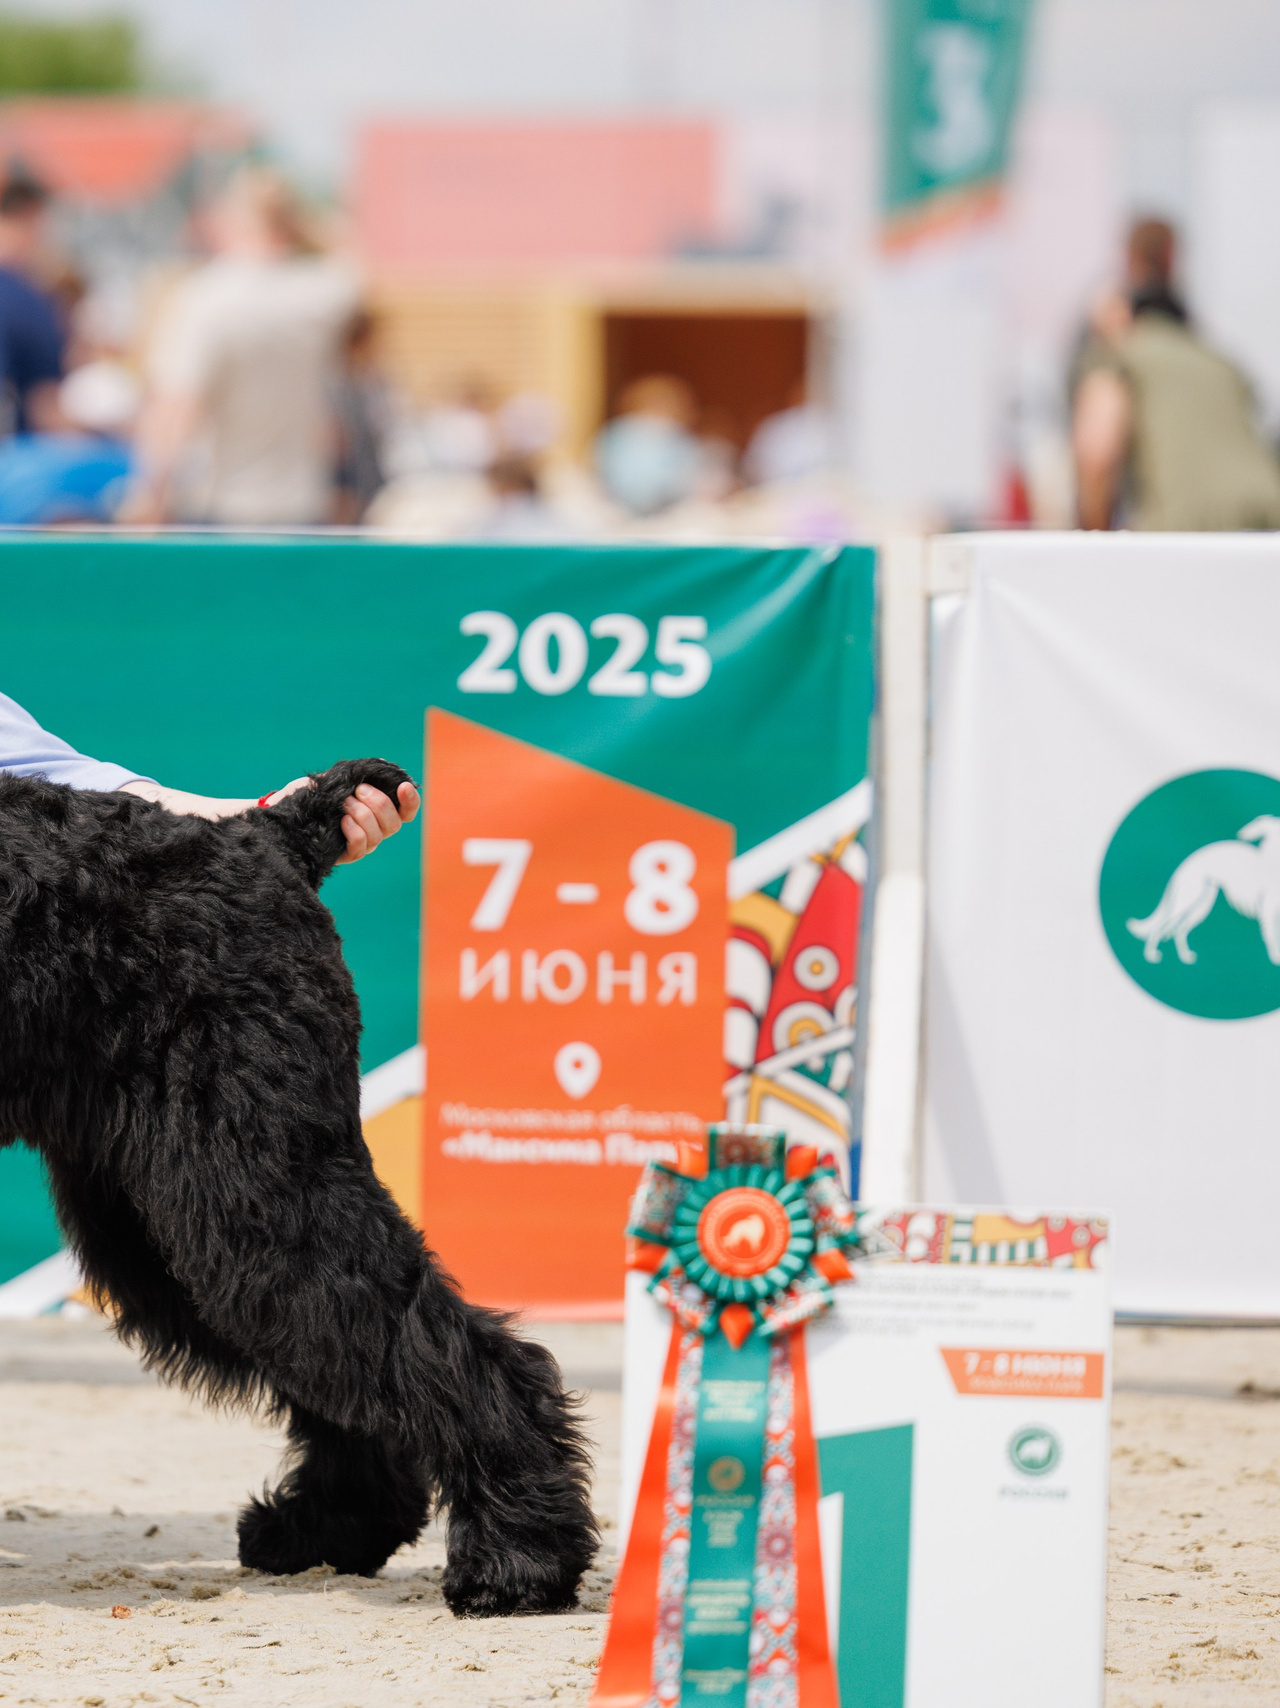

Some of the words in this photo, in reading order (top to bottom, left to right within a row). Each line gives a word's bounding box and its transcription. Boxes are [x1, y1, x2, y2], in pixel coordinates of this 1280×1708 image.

[457, 611, 713, 698] 2025
[462, 837, 533, 932] 7
[623, 840, 699, 935] 8
[458, 947, 699, 1005] ИЮНЯ
